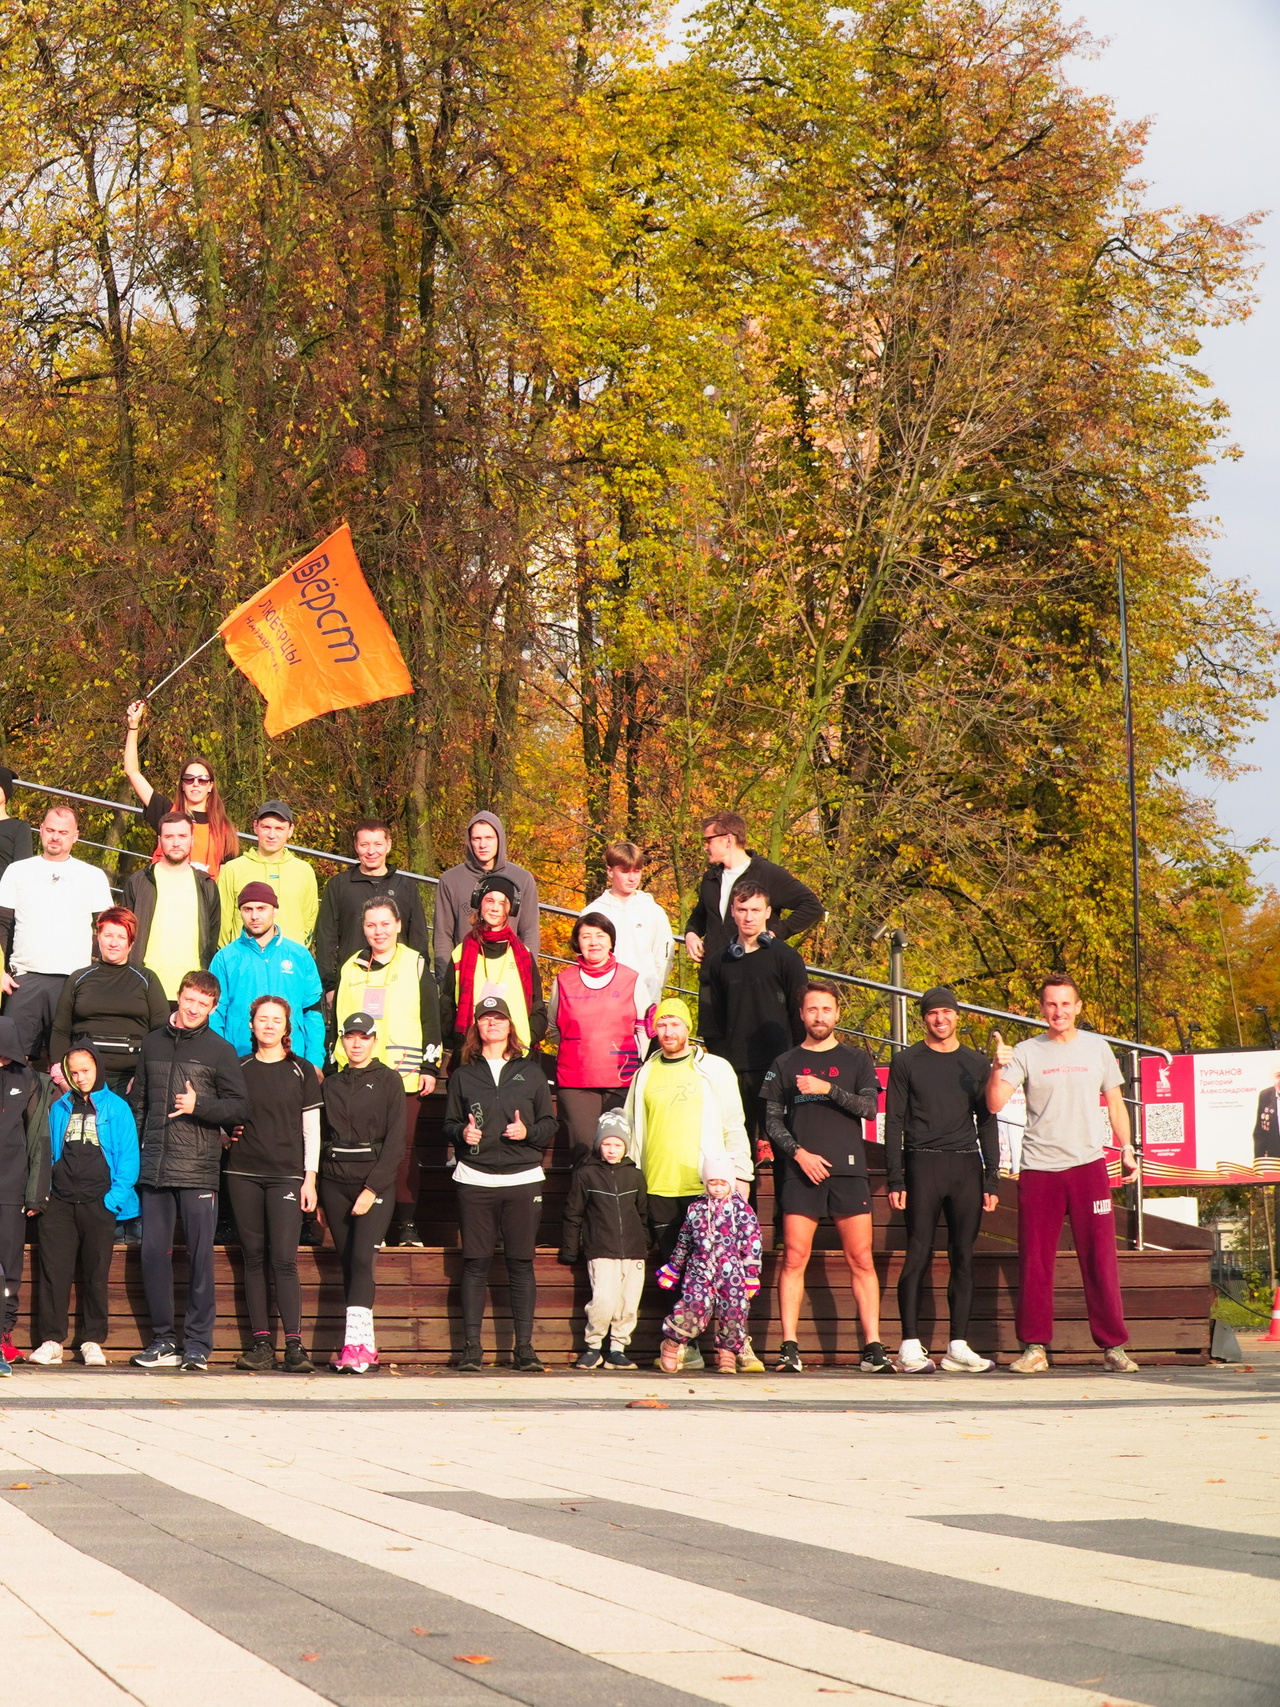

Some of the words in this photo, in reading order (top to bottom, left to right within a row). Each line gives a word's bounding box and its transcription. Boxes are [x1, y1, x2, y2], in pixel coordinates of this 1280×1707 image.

[258, 599, 302, 666] ЛЮБЕРЦЫ
[1200, 1068, 1242, 1077] ТУРЧАНОВ
[1200, 1079, 1233, 1087] Григорий
[1200, 1087, 1258, 1095] Александрович
